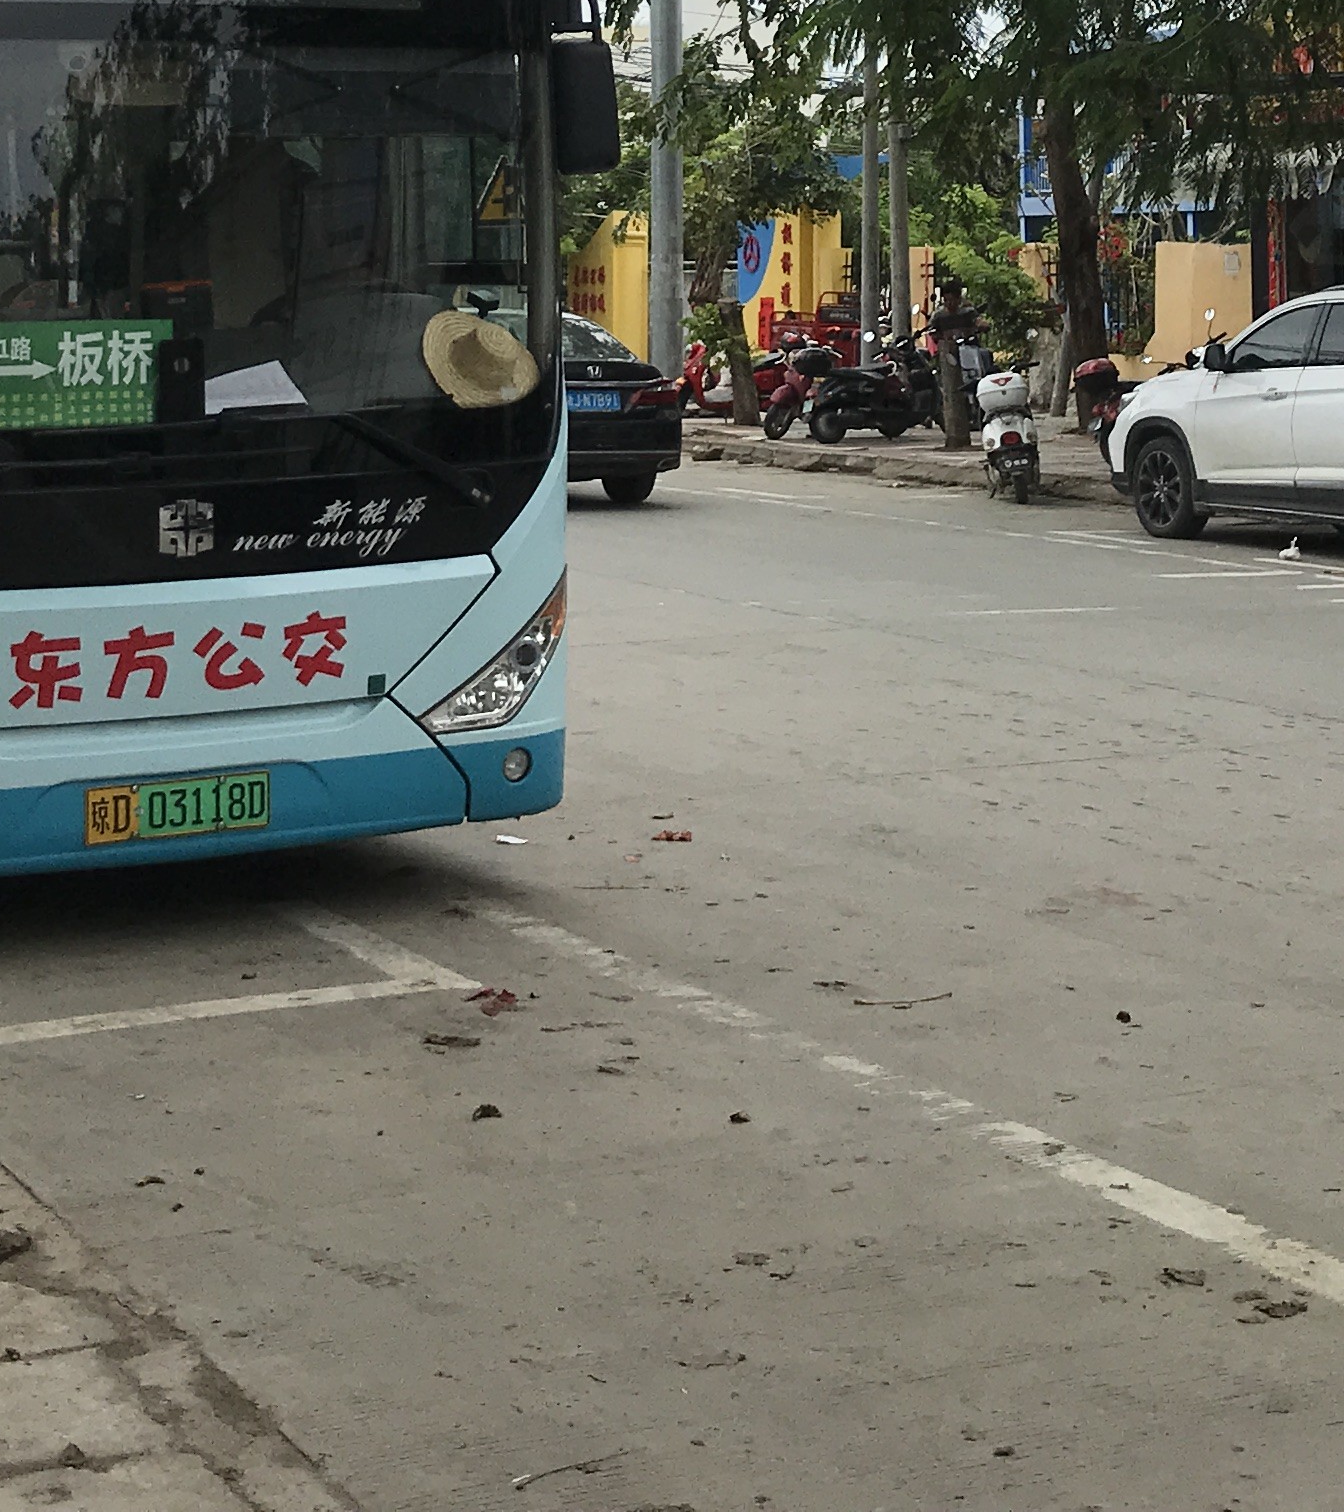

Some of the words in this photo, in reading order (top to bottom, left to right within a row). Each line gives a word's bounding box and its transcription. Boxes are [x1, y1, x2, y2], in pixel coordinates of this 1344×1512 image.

[58, 329, 154, 387] 板桥
[313, 496, 428, 529] 新能源
[232, 532, 298, 552] new
[306, 524, 407, 559] energy
[8, 610, 348, 710] 东方公交
